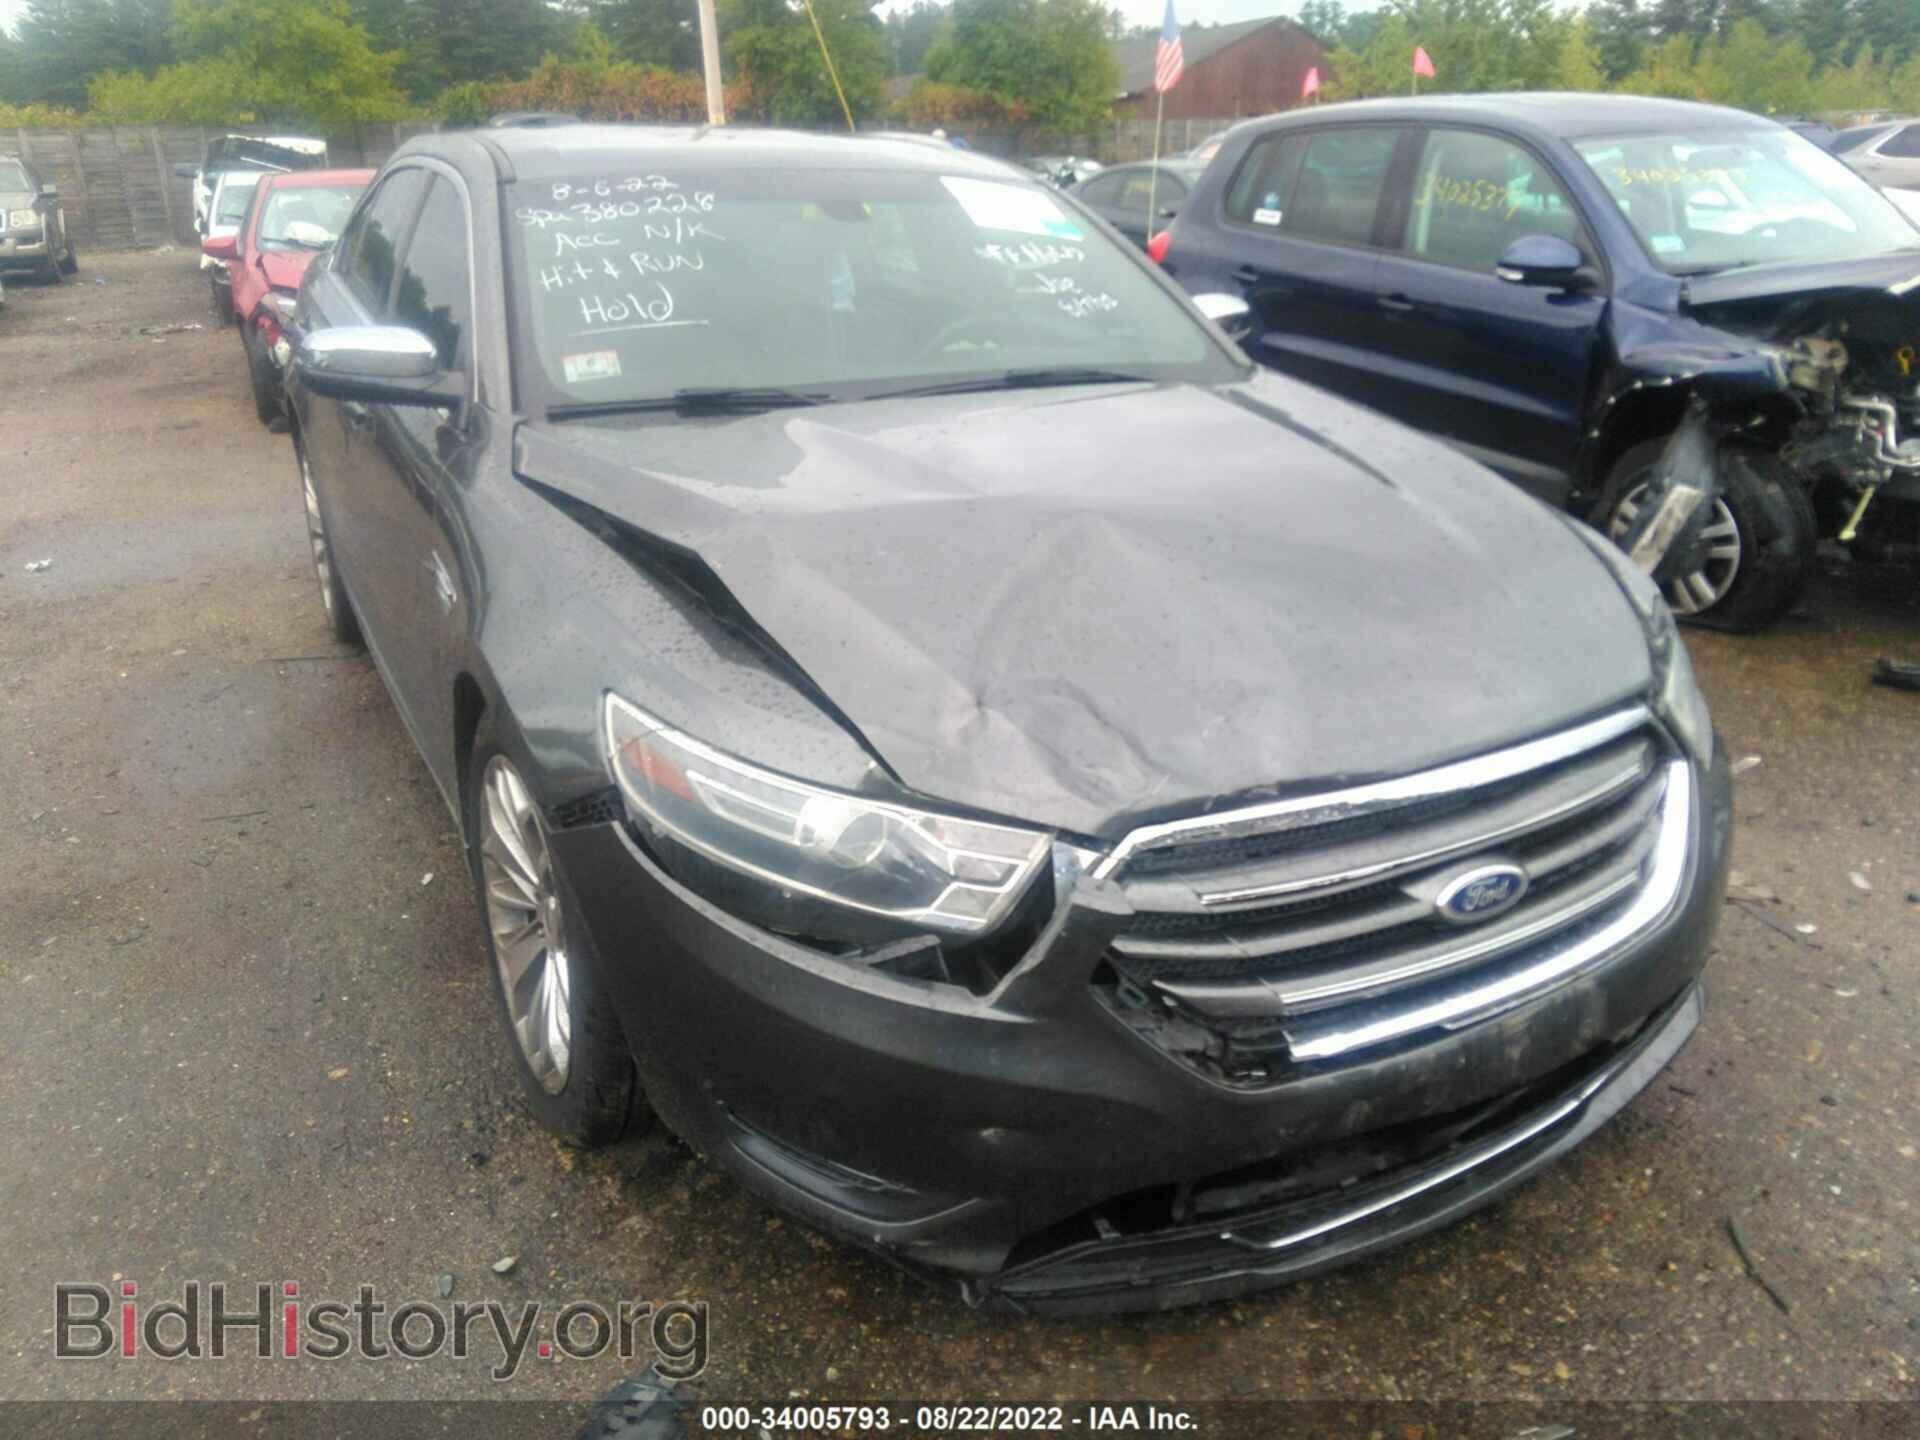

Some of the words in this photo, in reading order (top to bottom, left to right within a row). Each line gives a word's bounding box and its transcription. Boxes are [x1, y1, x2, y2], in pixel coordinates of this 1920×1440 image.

[551, 174, 679, 201] 8-6-22
[579, 281, 674, 324] Hold
[1461, 877, 1512, 912] Ford
